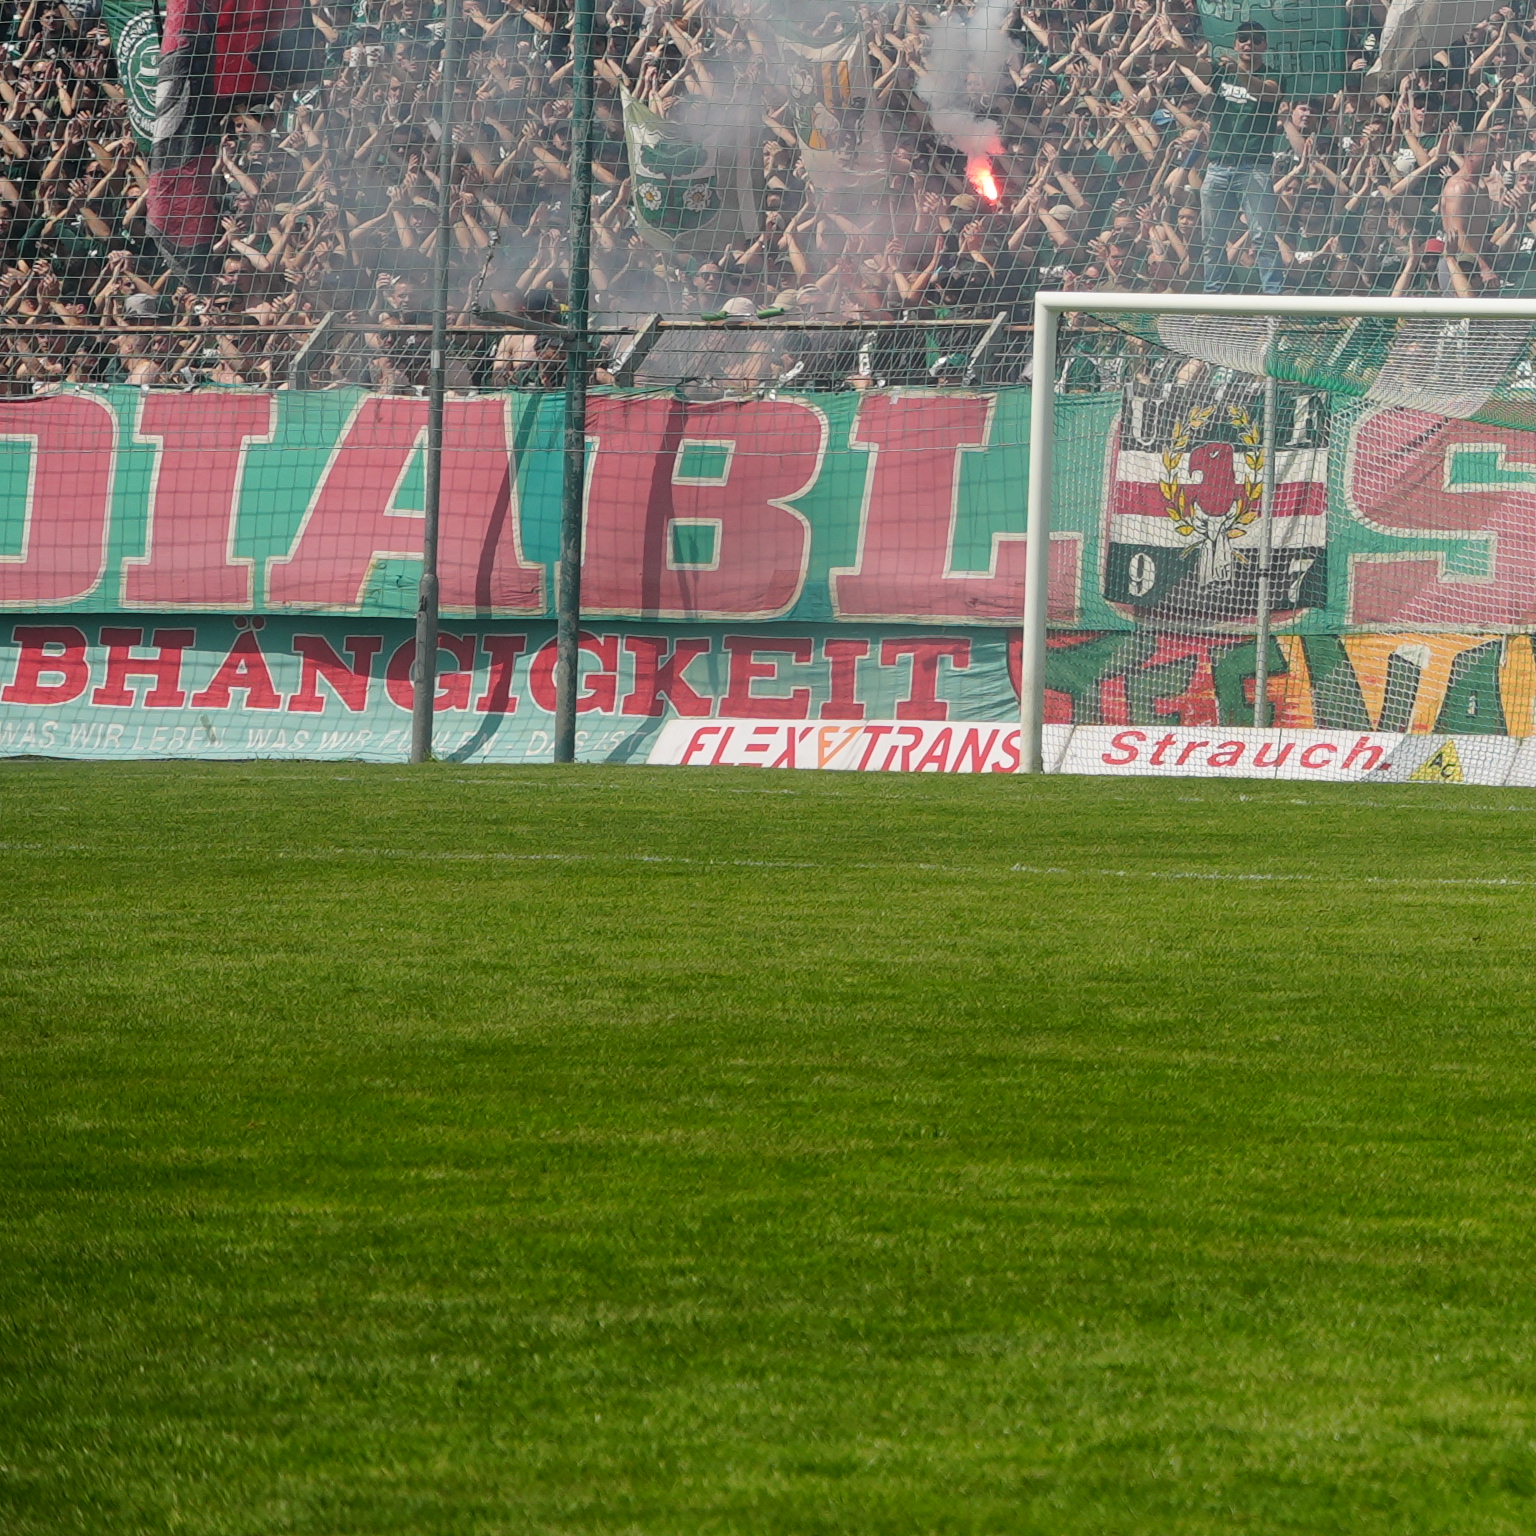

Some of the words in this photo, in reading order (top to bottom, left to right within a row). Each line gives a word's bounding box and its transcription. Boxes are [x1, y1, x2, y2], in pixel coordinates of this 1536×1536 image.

[70, 721, 125, 750] WIR
[247, 727, 307, 753] WAS
[311, 728, 370, 753] WIR
[684, 725, 814, 772] FLEX
[859, 725, 1022, 774] TRANS
